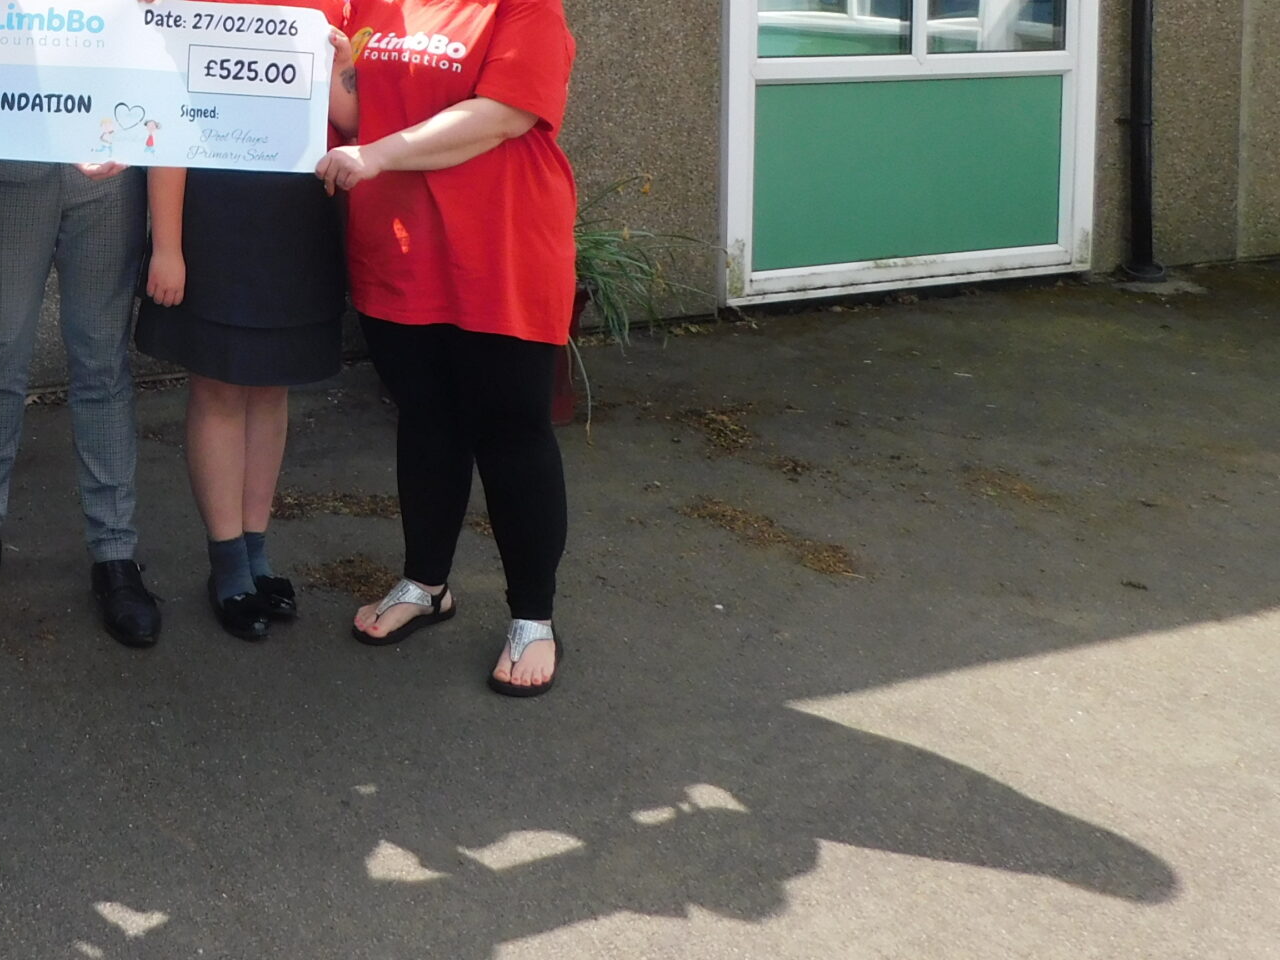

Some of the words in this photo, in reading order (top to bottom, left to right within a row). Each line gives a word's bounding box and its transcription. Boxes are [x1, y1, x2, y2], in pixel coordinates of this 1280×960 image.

[144, 8, 187, 29] Date:
[192, 13, 299, 37] 27/02/2026
[366, 31, 467, 59] LimbBo
[203, 58, 297, 85] £525.00
[363, 49, 463, 73] Foundation
[180, 103, 220, 122] Signed:
[231, 128, 270, 147] Hayes
[186, 145, 242, 164] Primary
[243, 148, 280, 162] School
